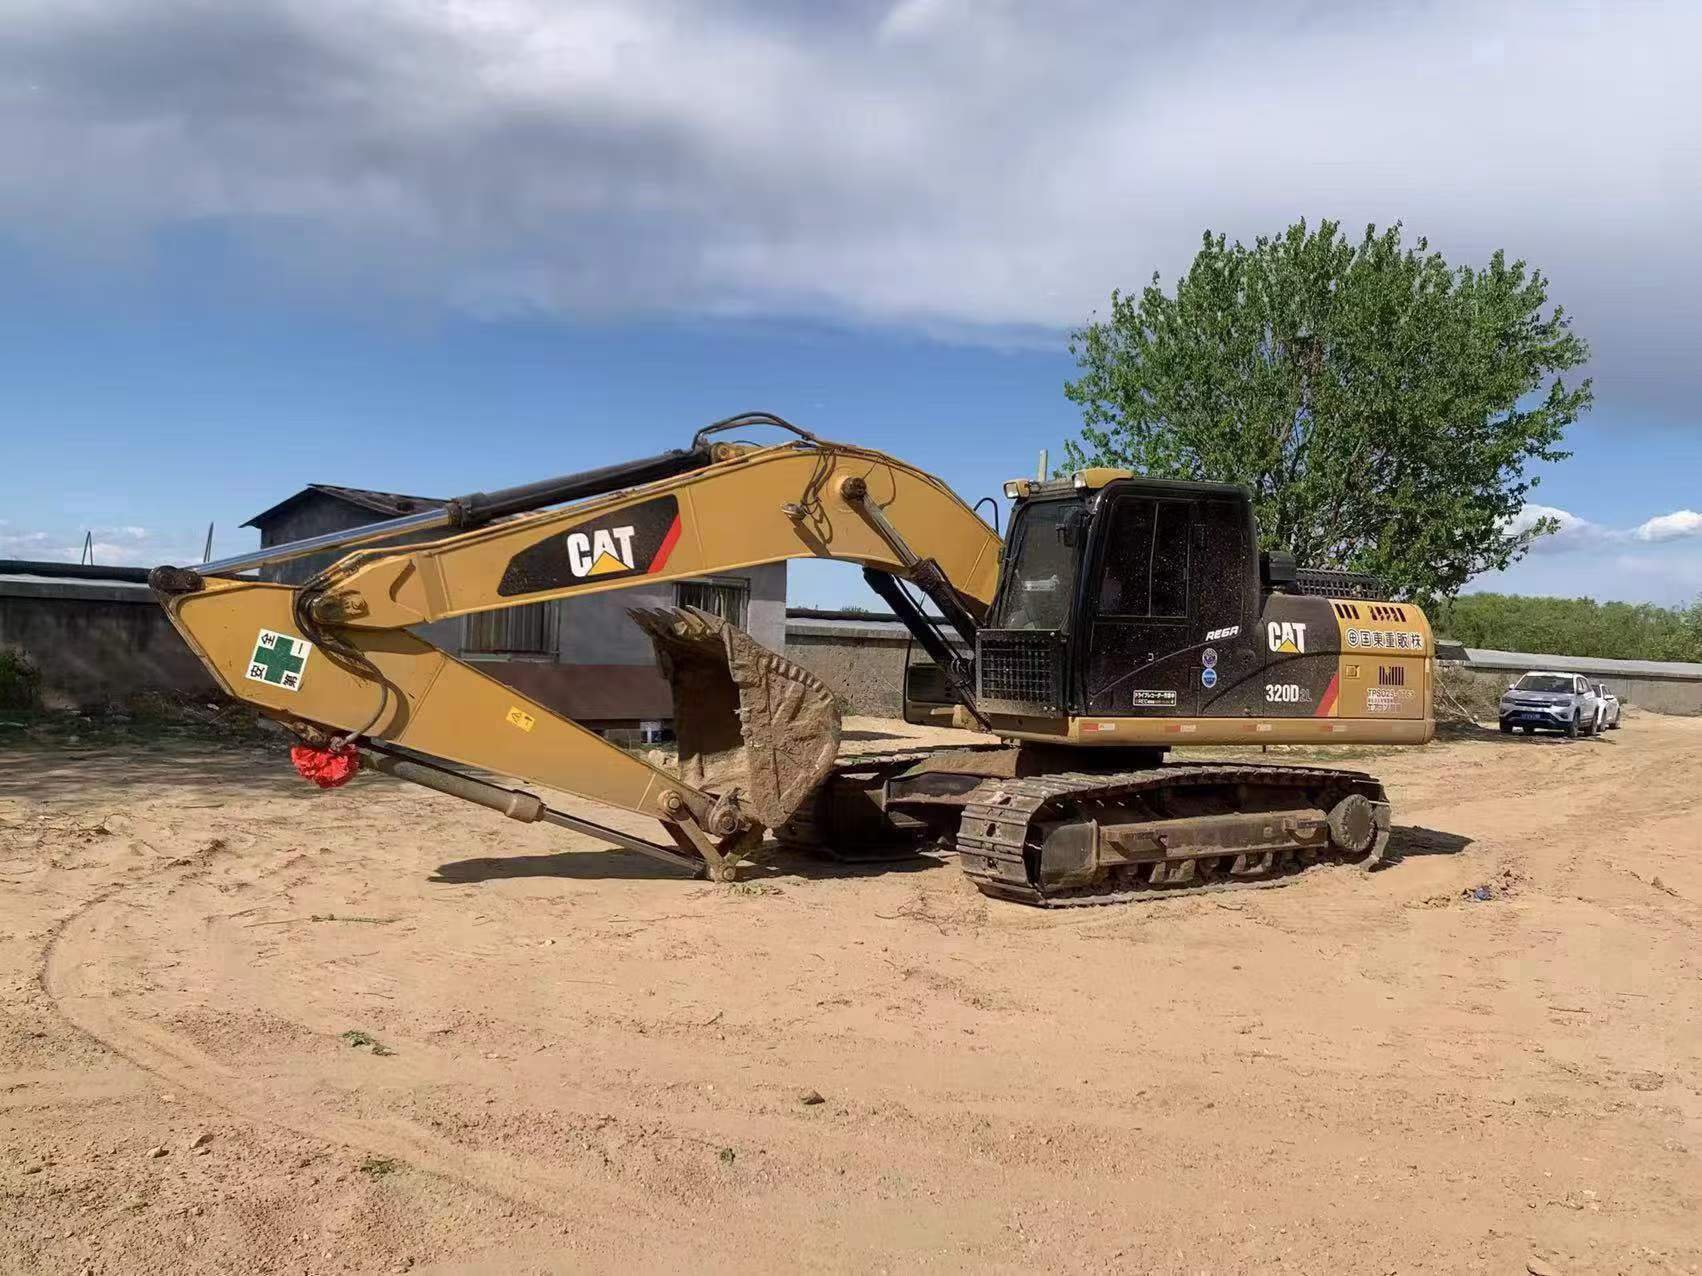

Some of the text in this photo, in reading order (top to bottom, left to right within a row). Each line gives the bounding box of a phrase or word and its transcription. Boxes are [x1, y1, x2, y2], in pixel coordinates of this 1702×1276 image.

[567, 525, 635, 577] CAT
[1267, 621, 1306, 654] CAT
[1265, 684, 1300, 702] 320D
